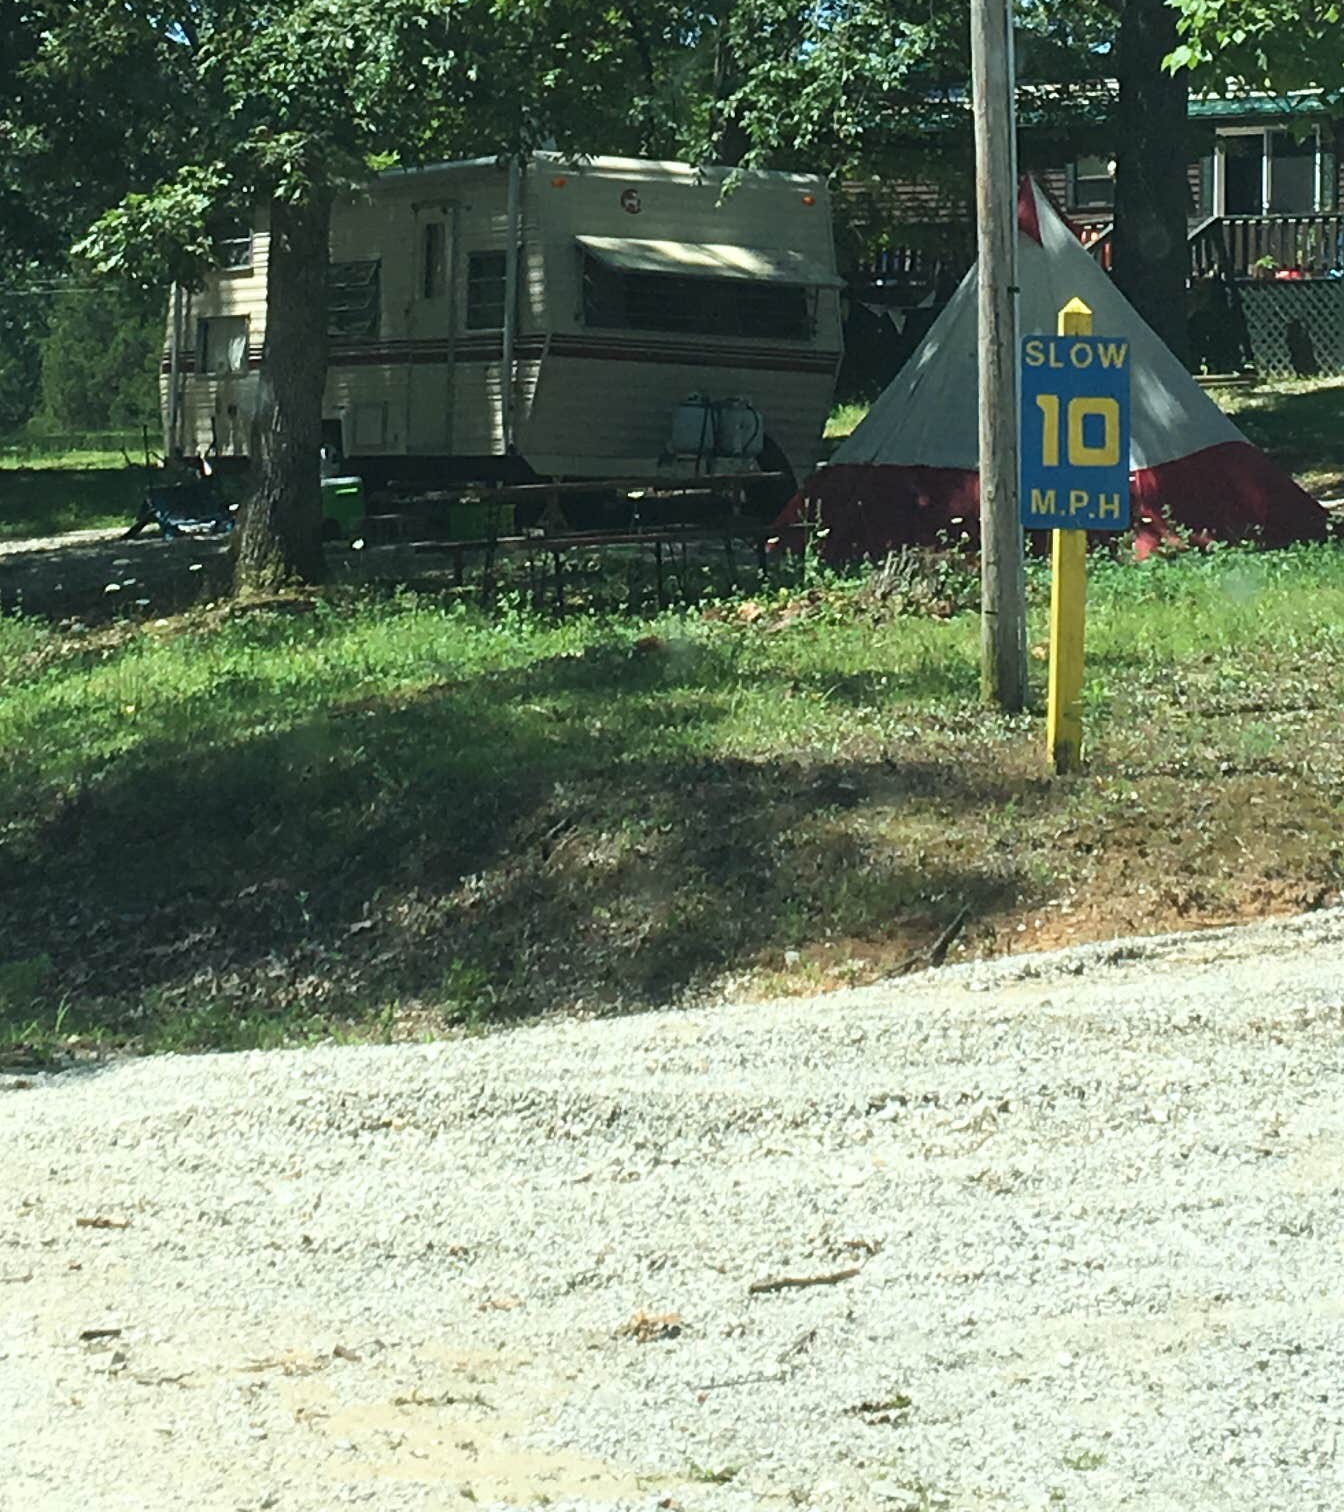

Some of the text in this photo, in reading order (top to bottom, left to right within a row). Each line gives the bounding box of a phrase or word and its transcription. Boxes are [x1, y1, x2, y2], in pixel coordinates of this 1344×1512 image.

[1025, 341, 1127, 368] SLOW
[1036, 394, 1120, 467] 10
[1030, 489, 1121, 519] M.P.H
